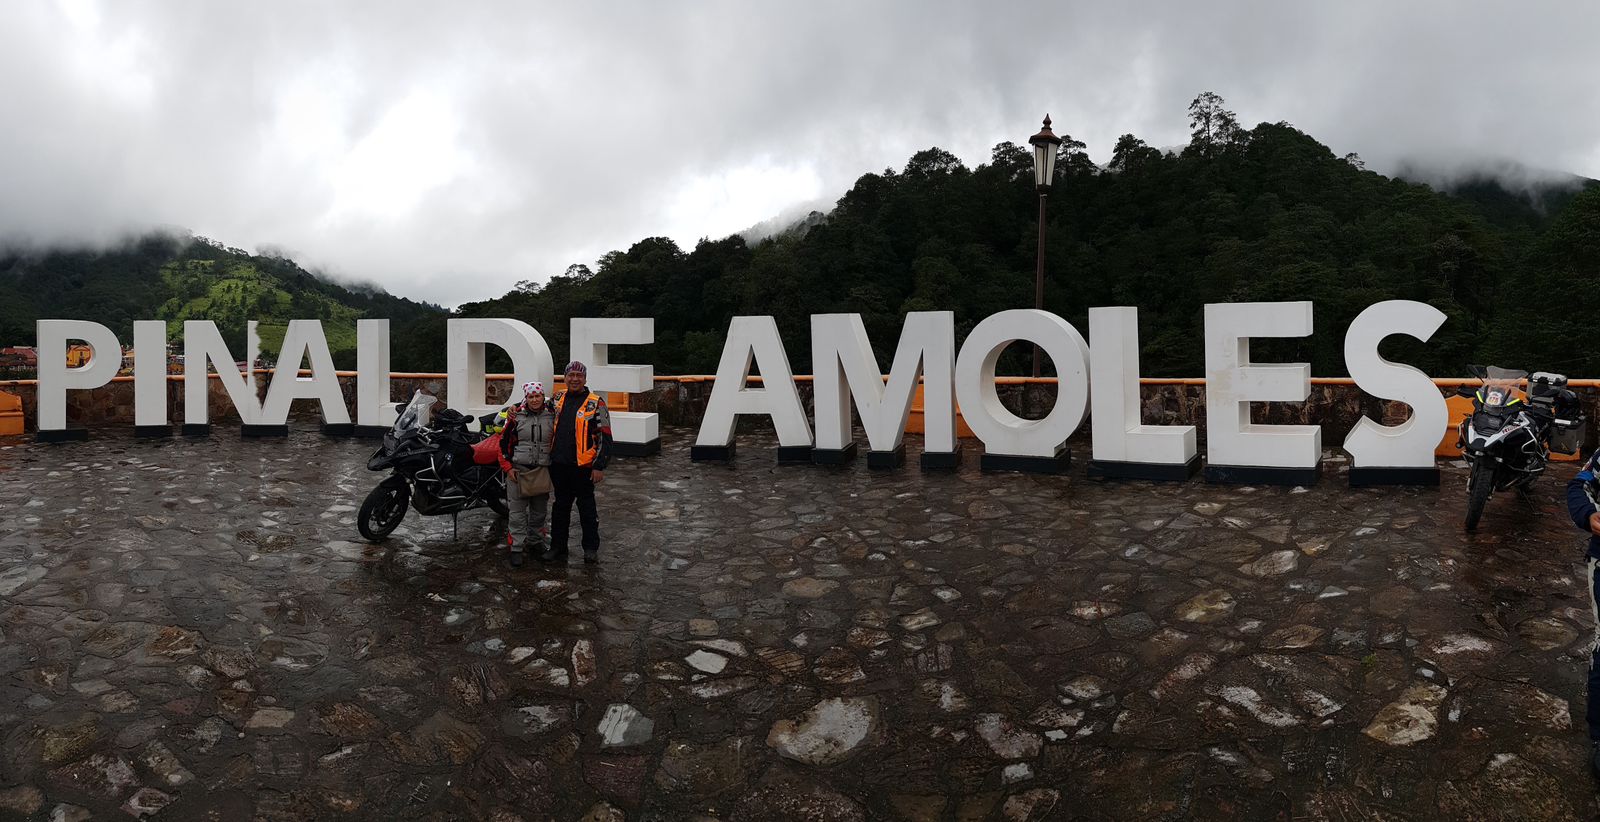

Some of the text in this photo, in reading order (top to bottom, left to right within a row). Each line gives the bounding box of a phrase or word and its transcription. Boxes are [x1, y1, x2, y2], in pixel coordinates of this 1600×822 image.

[36, 300, 1449, 469] PINAL DE AMOLES
